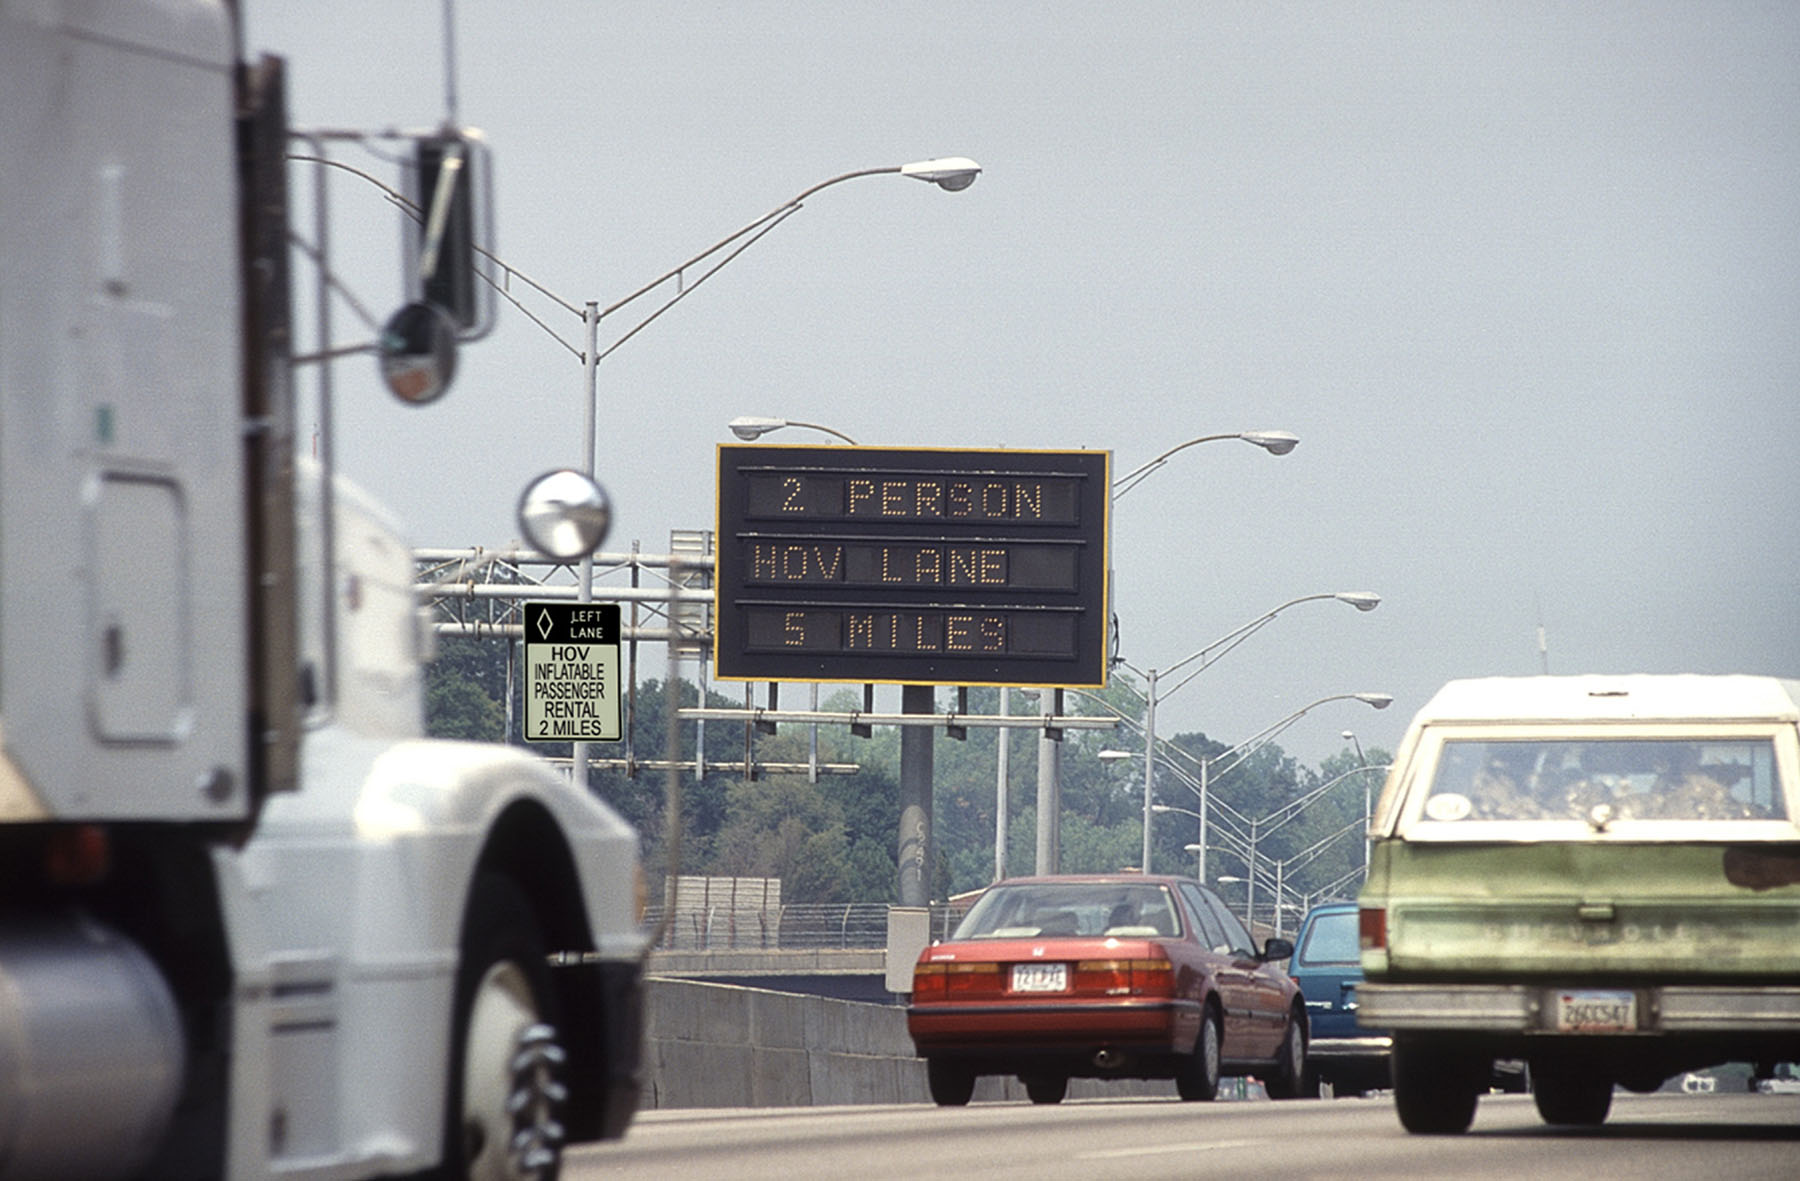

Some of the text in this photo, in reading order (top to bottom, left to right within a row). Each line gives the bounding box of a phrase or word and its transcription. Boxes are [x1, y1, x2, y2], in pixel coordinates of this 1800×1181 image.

[782, 477, 1042, 519] 2 PERSON
[753, 545, 1006, 585] HOV LANE
[571, 610, 602, 623] LEFT
[570, 627, 604, 639] LANE
[784, 612, 1004, 651] 5 MILES
[551, 646, 591, 662] HOV
[535, 663, 605, 680] INFLATABLE
[535, 682, 605, 699] PASSENGER
[545, 701, 600, 718] RENTAL
[539, 720, 602, 736] 2 MILES
